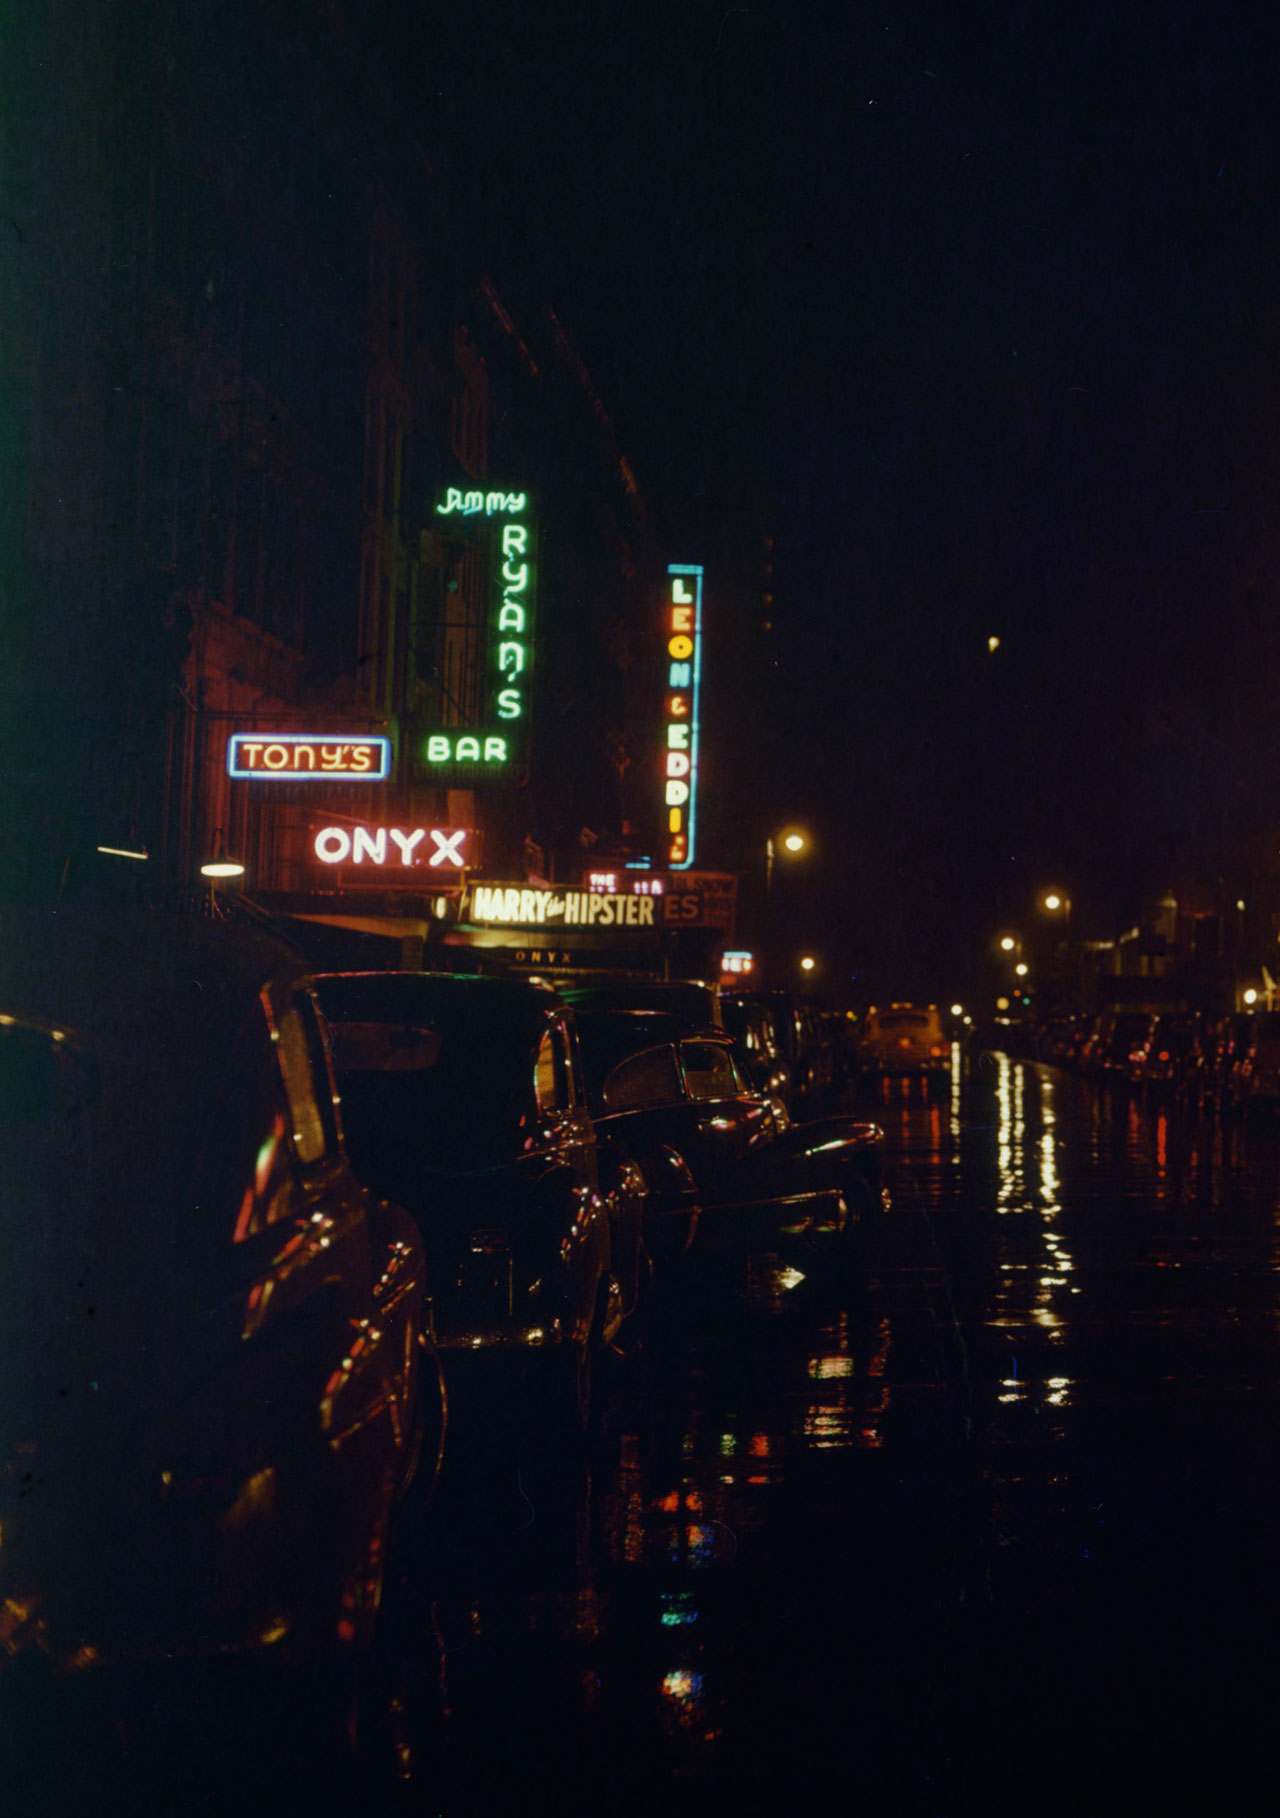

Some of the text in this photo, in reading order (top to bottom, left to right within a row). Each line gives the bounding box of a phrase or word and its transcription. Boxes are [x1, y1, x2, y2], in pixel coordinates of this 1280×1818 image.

[667, 578, 695, 688] LEON
[427, 735, 508, 763] BAR
[314, 826, 467, 868] ONYX
[474, 886, 551, 923] HARRY
[564, 892, 656, 926] HIPSTER
[515, 951, 572, 963] ONYX
